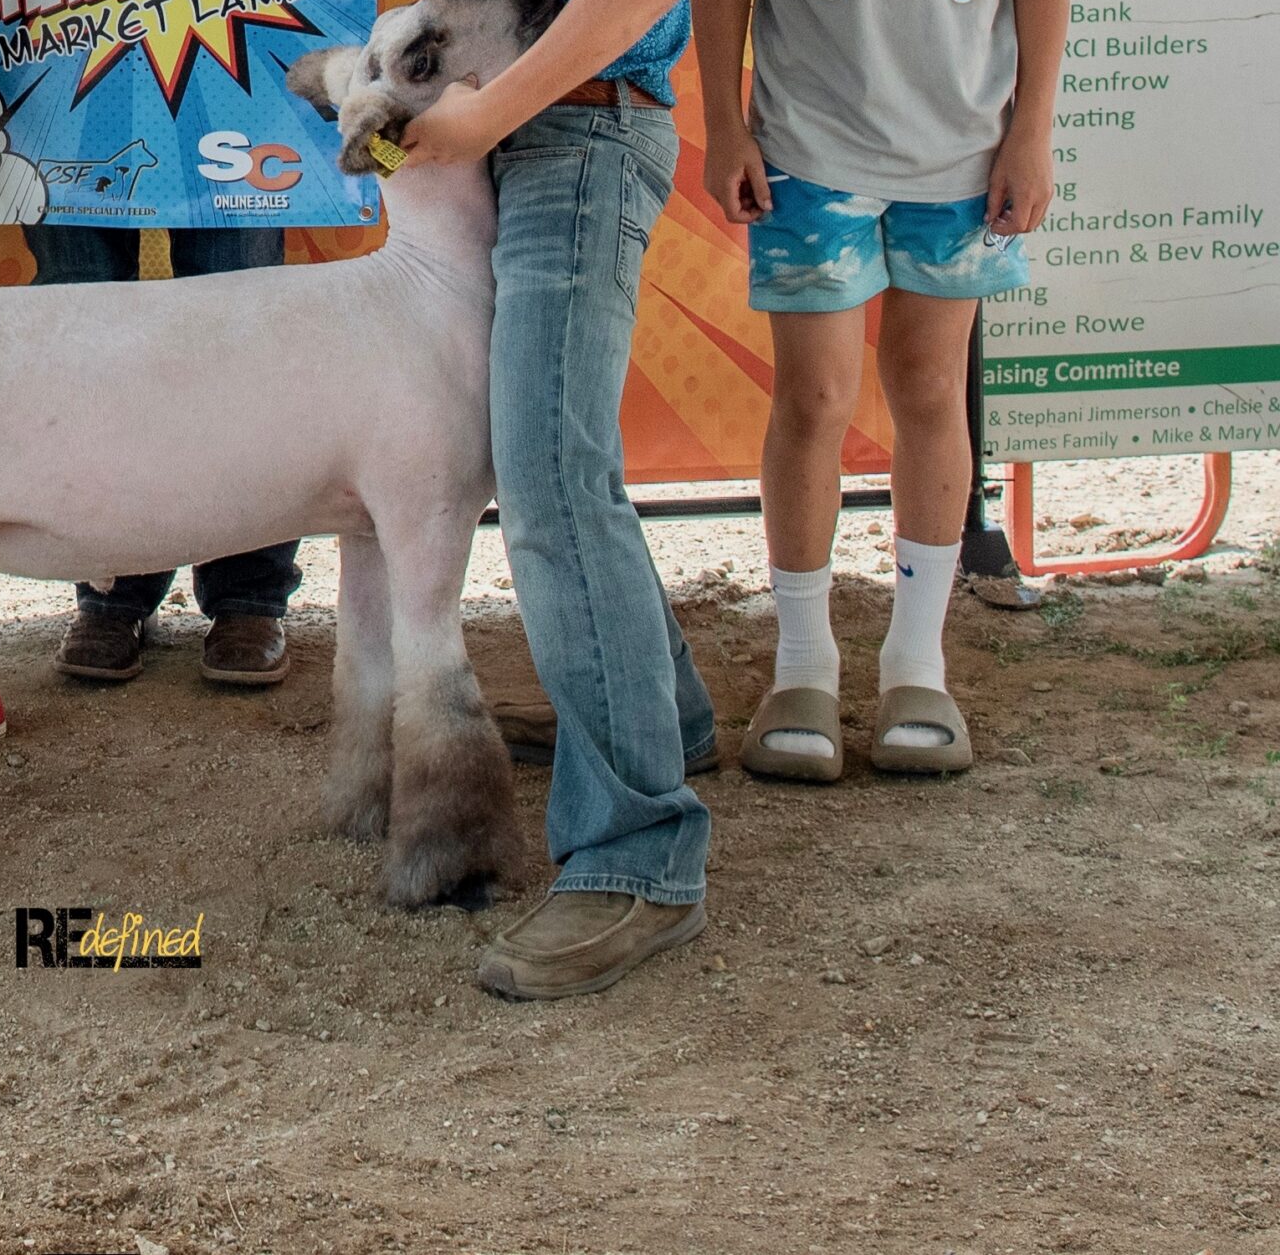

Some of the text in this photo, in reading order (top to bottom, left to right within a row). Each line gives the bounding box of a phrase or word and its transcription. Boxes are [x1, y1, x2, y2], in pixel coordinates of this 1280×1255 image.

[1070, 1, 1133, 24] Bank
[1106, 34, 1209, 57] Builders
[1062, 71, 1170, 94] Renfrow
[1053, 107, 1136, 130] vating
[197, 131, 303, 192] SC
[44, 165, 93, 185] CSF
[77, 206, 126, 215] SPECIALTY
[127, 207, 157, 216] FEEDS
[214, 194, 290, 210] ONLINE SALES
[1182, 204, 1264, 228] Family
[1046, 245, 1121, 266] Glenn
[1129, 243, 1149, 263] &
[1158, 244, 1204, 262] Bev
[1211, 240, 1280, 260] Rowe
[1075, 314, 1145, 334] Rowe
[983, 358, 1181, 387] aising Committee
[988, 410, 1002, 426] &
[1007, 407, 1083, 428] Stephani
[1088, 405, 1181, 423] Jimmerson
[1203, 399, 1263, 415] Chelsie
[1004, 436, 1058, 452] James
[1063, 431, 1118, 450] Family
[1152, 428, 1194, 444] Mike
[1199, 426, 1212, 442] &
[1218, 425, 1263, 442] Mary
